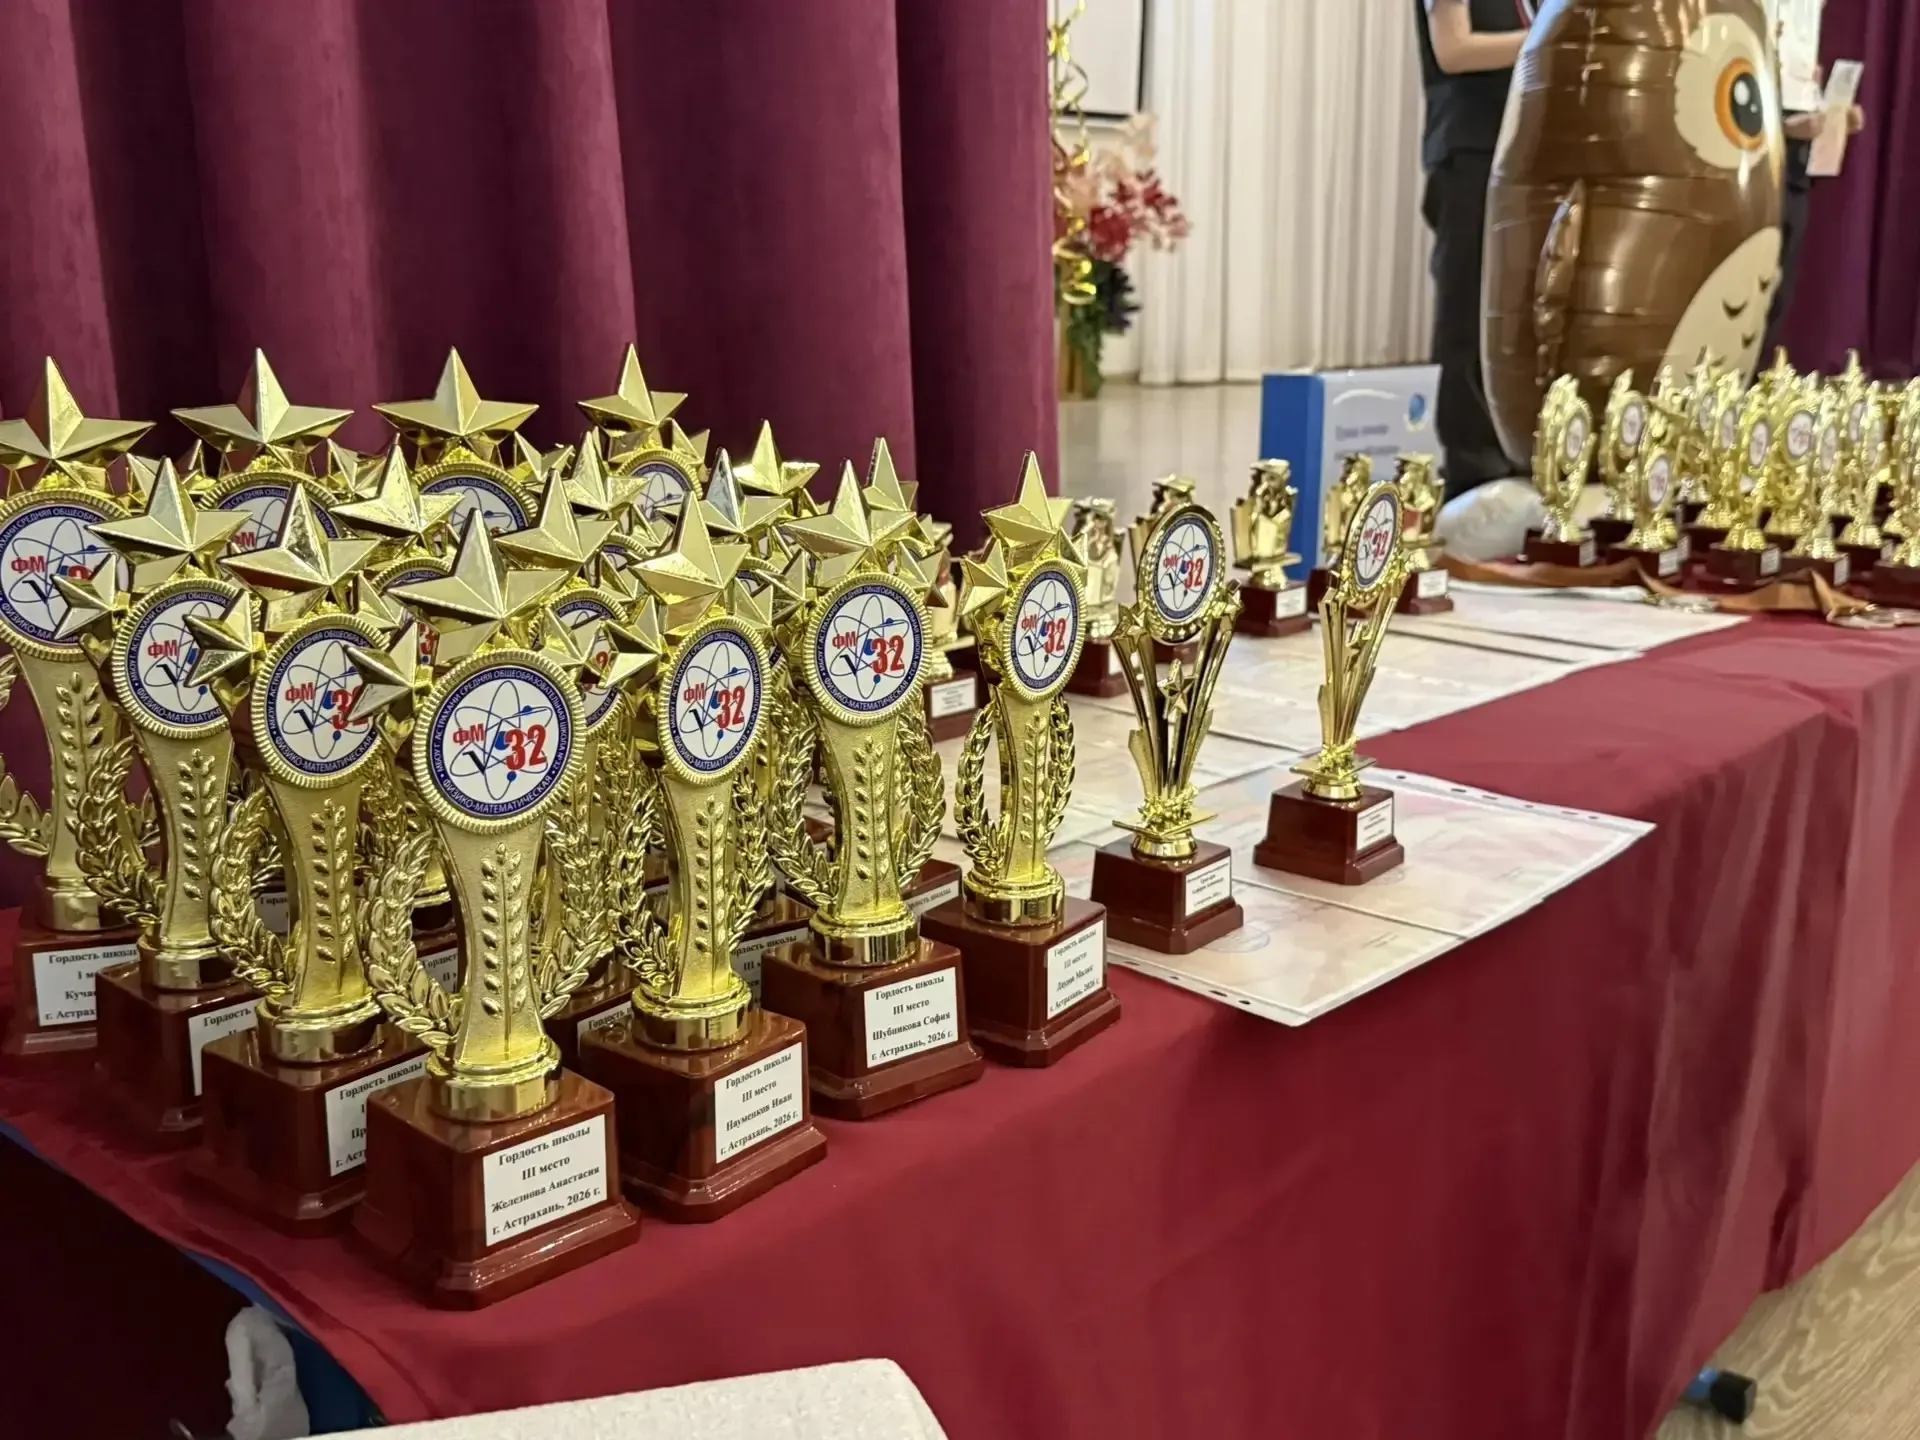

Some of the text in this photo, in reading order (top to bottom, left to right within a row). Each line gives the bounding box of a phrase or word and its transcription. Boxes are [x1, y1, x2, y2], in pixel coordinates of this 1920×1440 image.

[10, 555, 45, 574] ФМ
[1183, 558, 1204, 589] 32
[147, 640, 178, 659] ФМ
[1021, 614, 1067, 654] ФМ 32
[832, 631, 905, 674] ФМ 32
[285, 682, 316, 703] ФМ
[683, 682, 746, 729] ФМ 32
[434, 692, 462, 740] АСТРАХАНИ
[559, 720, 569, 751] ШКОЛА
[274, 734, 375, 772] ФИЗИКО-МАТЕМАТИЧЕСКАЯ
[453, 723, 548, 771] ФМ 32
[442, 774, 554, 813] ФИЗИКО-МАТЕМАТИЧЕСКАЯ
[48, 953, 100, 964] Гордость
[422, 953, 457, 969] Гордост
[731, 943, 765, 958] ордость
[875, 976, 945, 1001] Гордость школы
[56, 1007, 96, 1020] Астрах
[203, 1008, 252, 1027] Гордость
[893, 999, 930, 1016] III место
[923, 1012, 951, 1026] София
[879, 1040, 926, 1059] Астрахань,
[927, 1031, 946, 1044] 2026
[339, 1061, 423, 1100] Гордость школы
[726, 1053, 792, 1090] Гордость школы
[742, 1080, 777, 1103] III место
[726, 1093, 793, 1132] Науменков Иван
[498, 1126, 590, 1167] Гордость школы
[727, 1124, 773, 1152] Астрахань,
[773, 1112, 792, 1128] 2026
[521, 1156, 571, 1181] III место
[491, 1166, 600, 1213] Железнова Анастасия
[492, 1186, 601, 1236] г. Астрахань, 2026 г.
